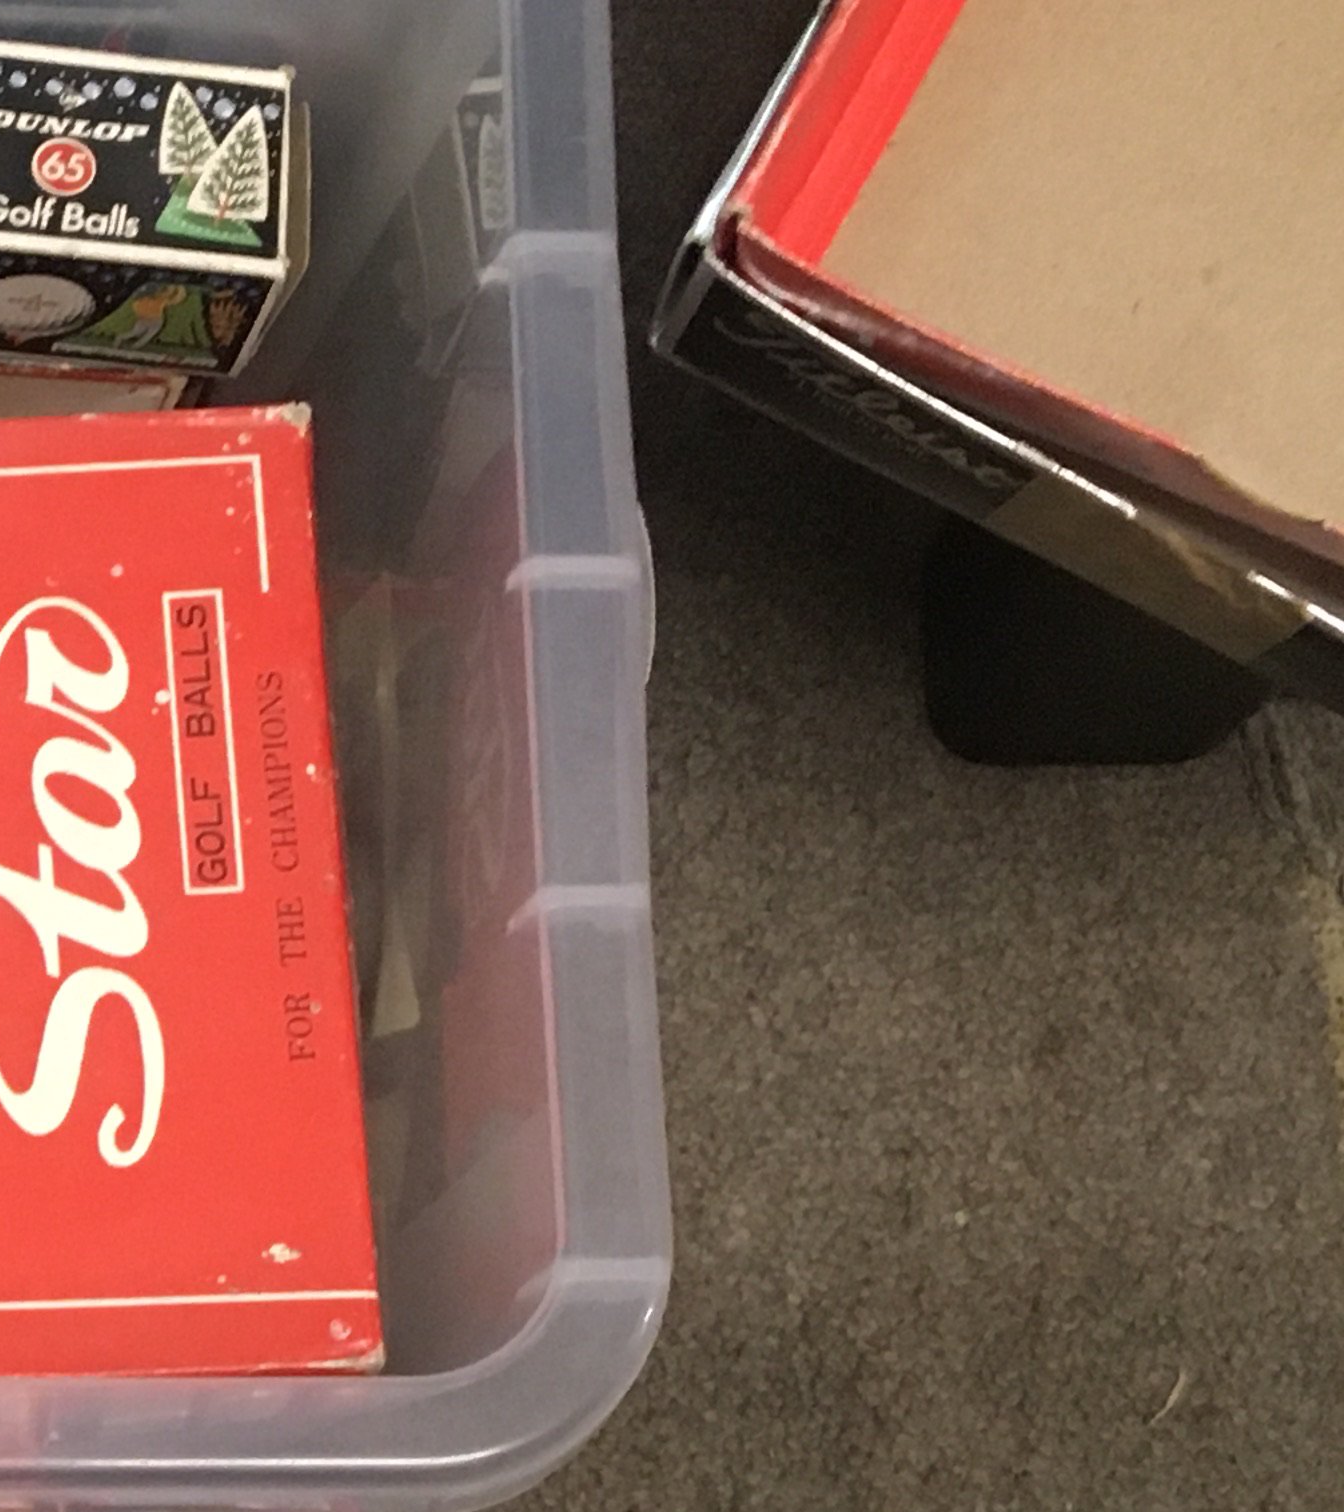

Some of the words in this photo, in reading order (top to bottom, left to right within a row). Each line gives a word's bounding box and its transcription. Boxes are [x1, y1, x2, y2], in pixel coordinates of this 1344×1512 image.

[42, 149, 87, 183] 65
[61, 202, 141, 238] Balls
[176, 603, 216, 737] BALLS
[256, 671, 300, 873] CHAMPIONS
[190, 777, 230, 885] GOLF
[277, 897, 307, 968] THE
[284, 991, 315, 1062] FOR
